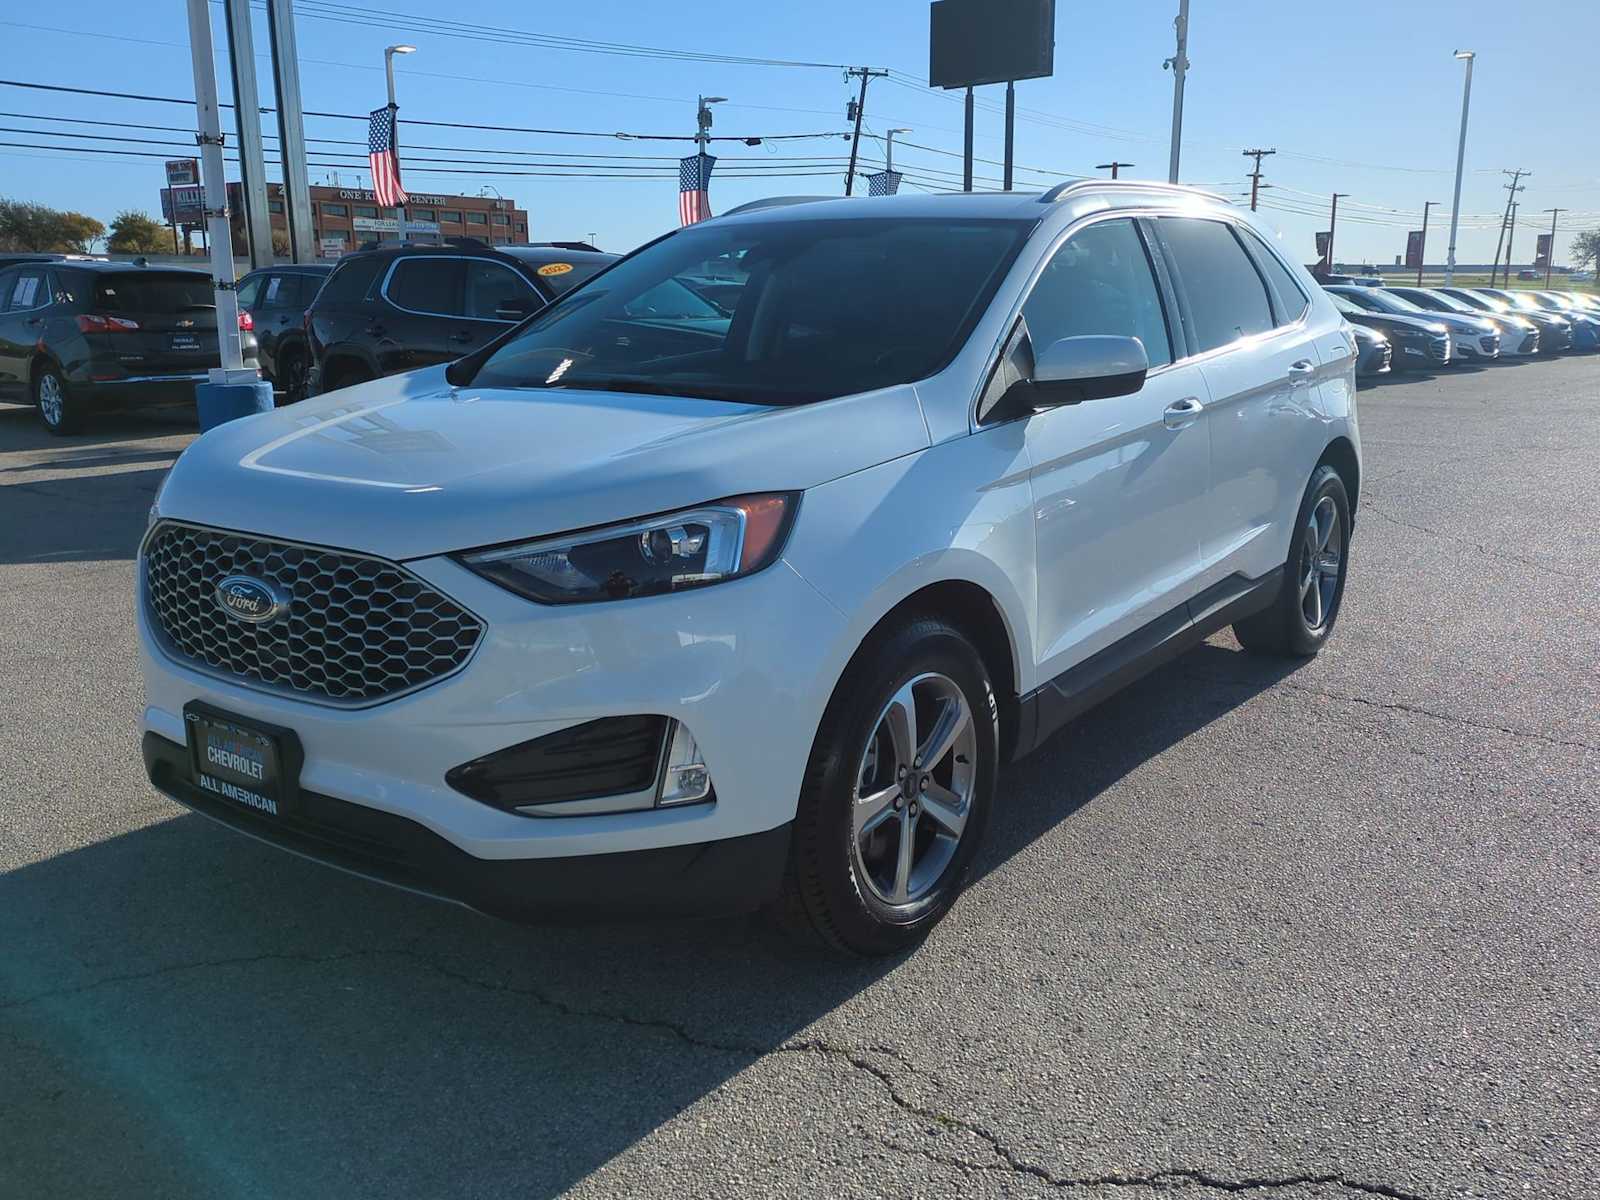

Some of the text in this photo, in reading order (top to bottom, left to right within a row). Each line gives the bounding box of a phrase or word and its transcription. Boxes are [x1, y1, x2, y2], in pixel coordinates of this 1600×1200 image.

[340, 190, 361, 200] ONE
[410, 195, 446, 205] CENTER
[227, 586, 260, 612] Ford
[207, 746, 264, 780] CHEVROLET
[200, 774, 277, 816] ALL AMERICAN
